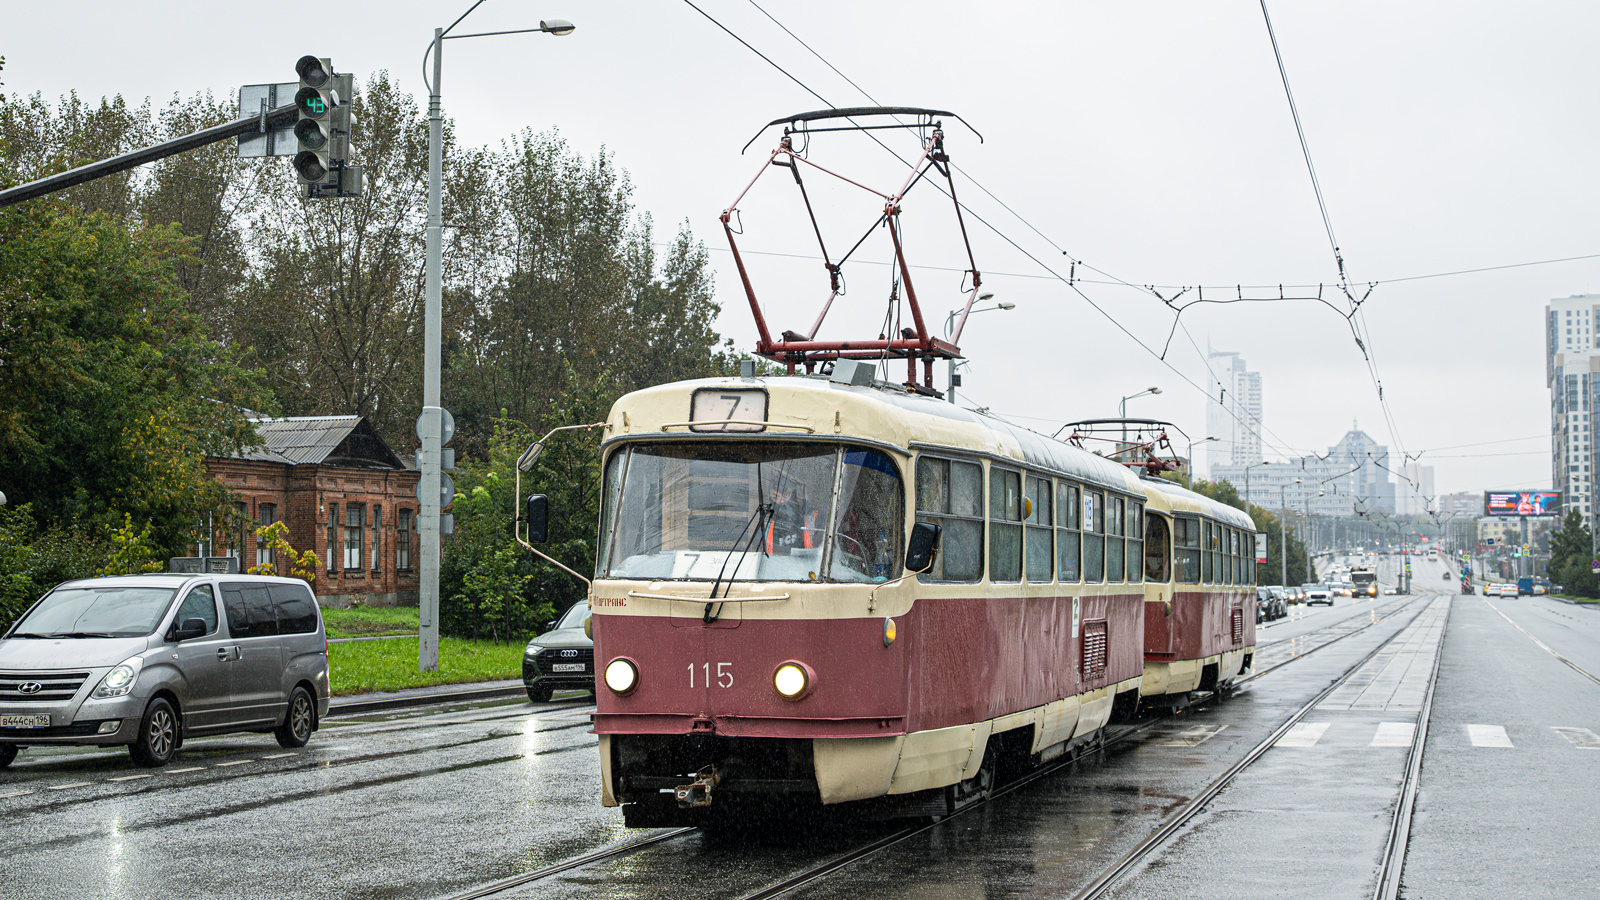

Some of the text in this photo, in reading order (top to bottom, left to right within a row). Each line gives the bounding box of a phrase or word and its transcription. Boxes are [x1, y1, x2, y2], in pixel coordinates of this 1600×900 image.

[307, 97, 324, 113] 43
[720, 395, 742, 431] 7
[683, 553, 701, 578] 7
[687, 662, 734, 688] 115
[3, 715, 49, 726] В444СН 196
